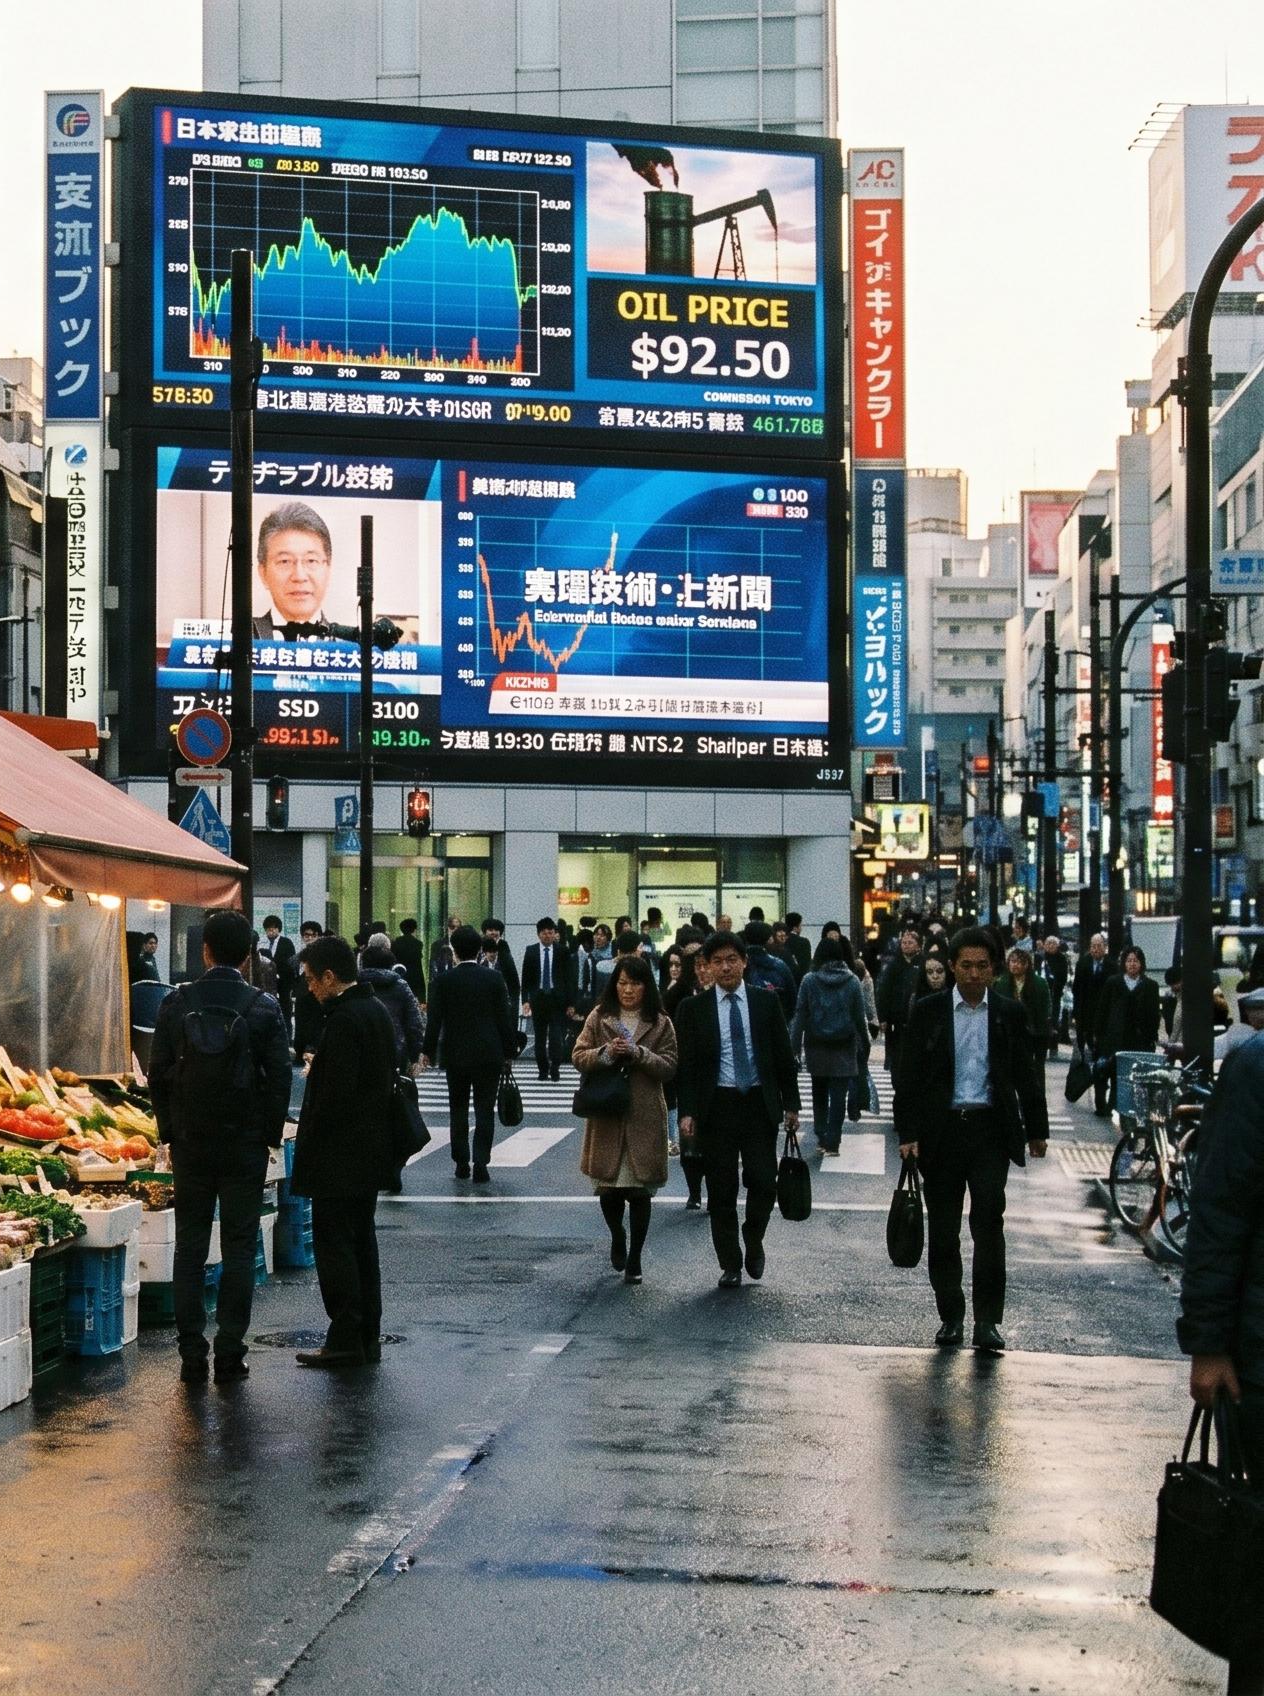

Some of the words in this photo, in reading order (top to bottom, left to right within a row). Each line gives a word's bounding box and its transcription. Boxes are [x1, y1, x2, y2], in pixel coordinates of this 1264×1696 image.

[618, 290, 678, 322] OIL
[688, 294, 789, 328] PRICE
[631, 331, 791, 380] $92.50
[773, 395, 813, 407] TOKYO
[278, 699, 320, 718] SSD
[494, 732, 544, 751] 19:30
